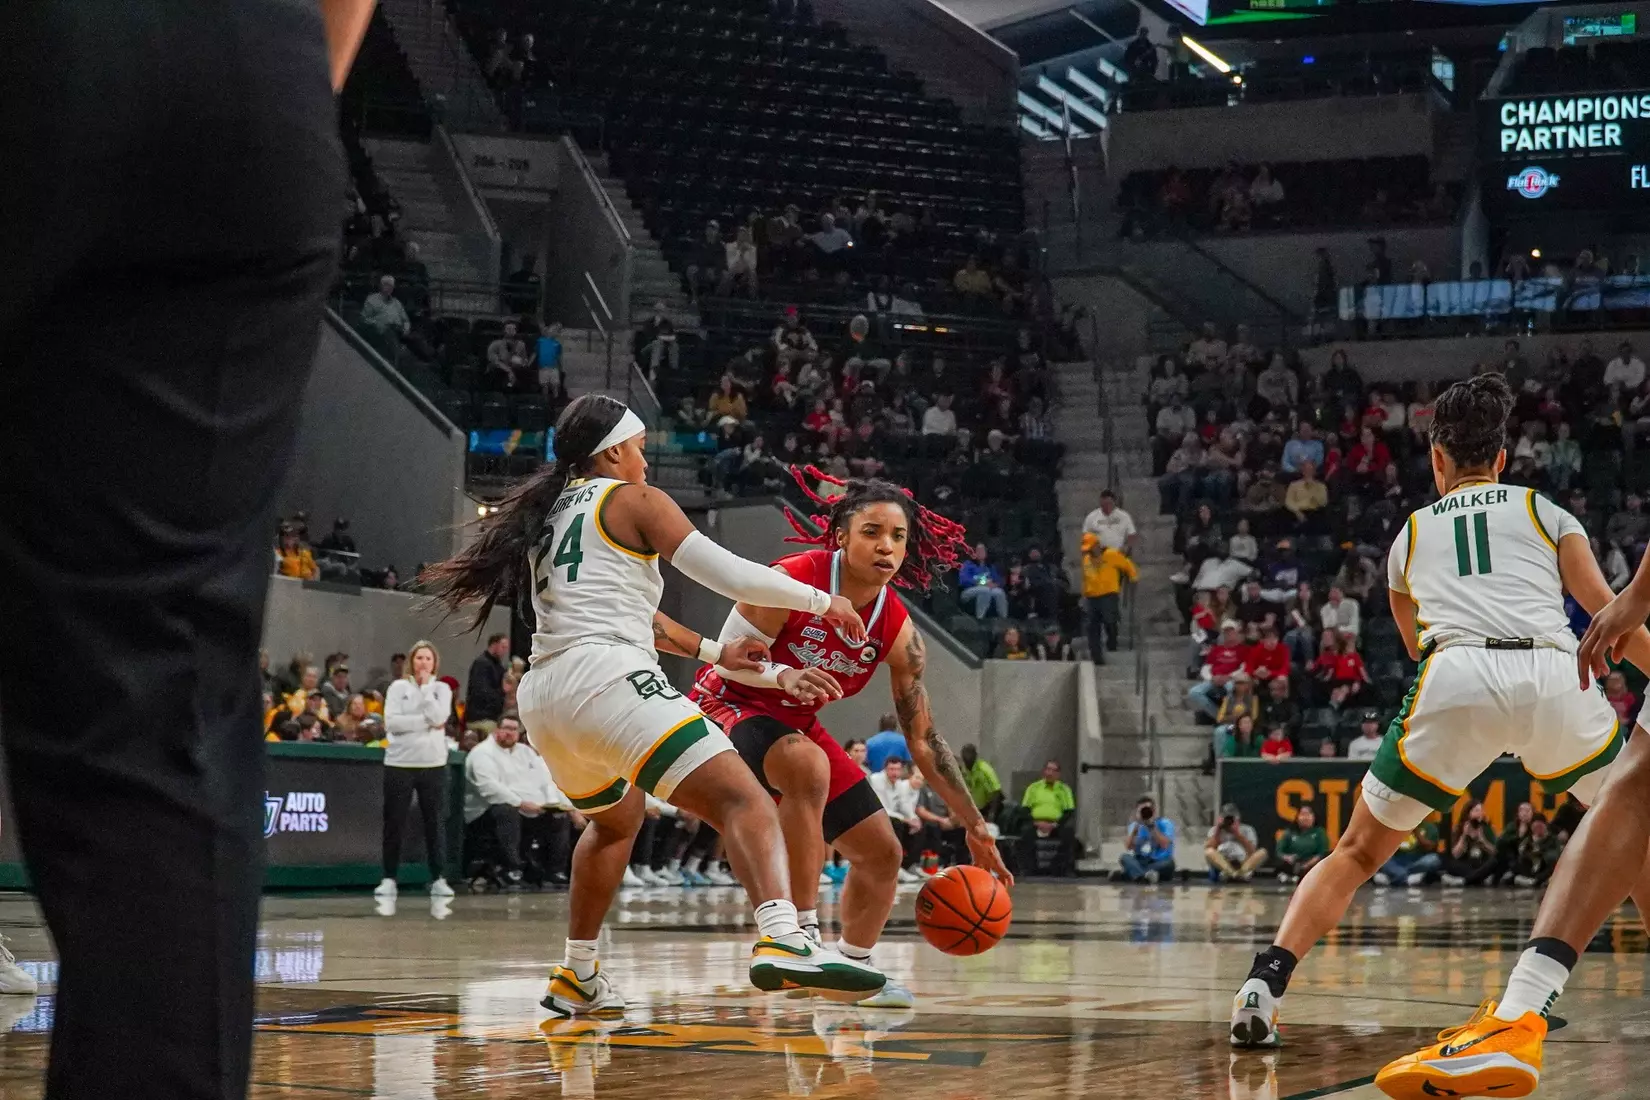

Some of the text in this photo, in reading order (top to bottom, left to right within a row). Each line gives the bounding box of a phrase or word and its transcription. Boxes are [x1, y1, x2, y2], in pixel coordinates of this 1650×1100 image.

[1501, 123, 1621, 152] PARTNER
[551, 485, 598, 515] DREWS
[1432, 490, 1508, 516] WALKER
[535, 513, 585, 596] 24
[1454, 512, 1492, 577] 11
[285, 792, 326, 812] AUTO
[280, 812, 329, 832] PARTS
